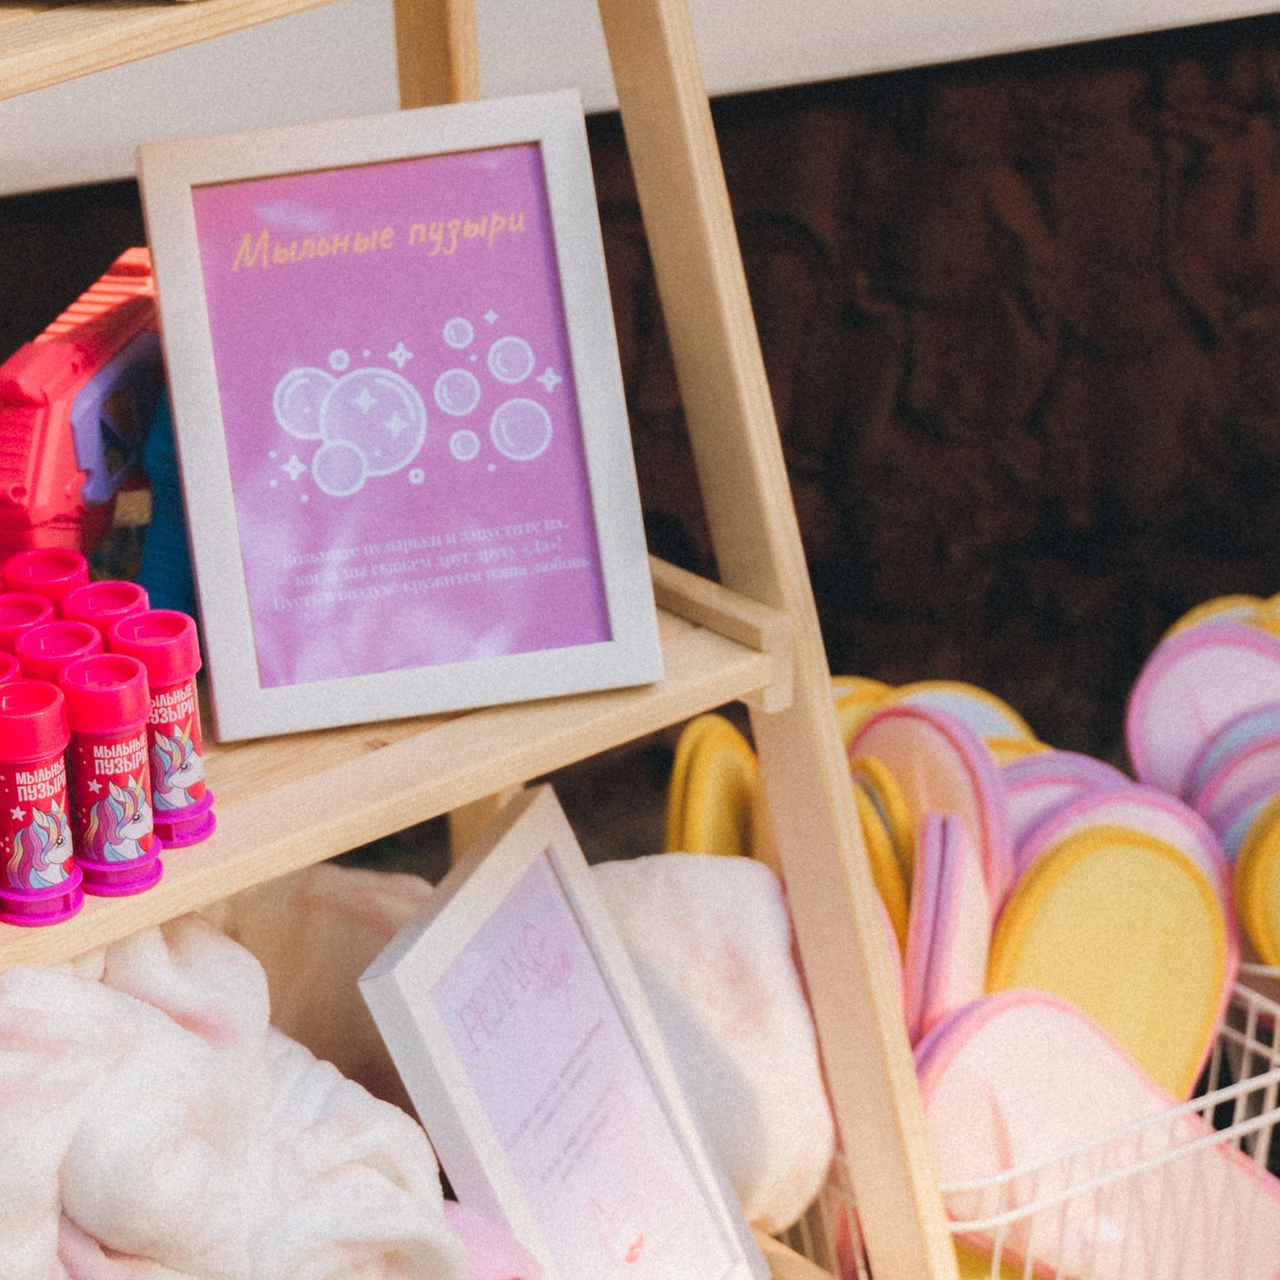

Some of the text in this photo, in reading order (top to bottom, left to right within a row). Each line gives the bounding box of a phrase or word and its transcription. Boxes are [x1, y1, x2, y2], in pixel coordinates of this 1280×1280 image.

[231, 212, 526, 272] Мыльные пузыри
[151, 683, 193, 708] ЫЛЬНЫЕ
[147, 697, 195, 724] УЗЫРИ
[93, 732, 146, 758] МЫЛЬНЫЕ
[95, 746, 147, 775] ПУЗЫРИ
